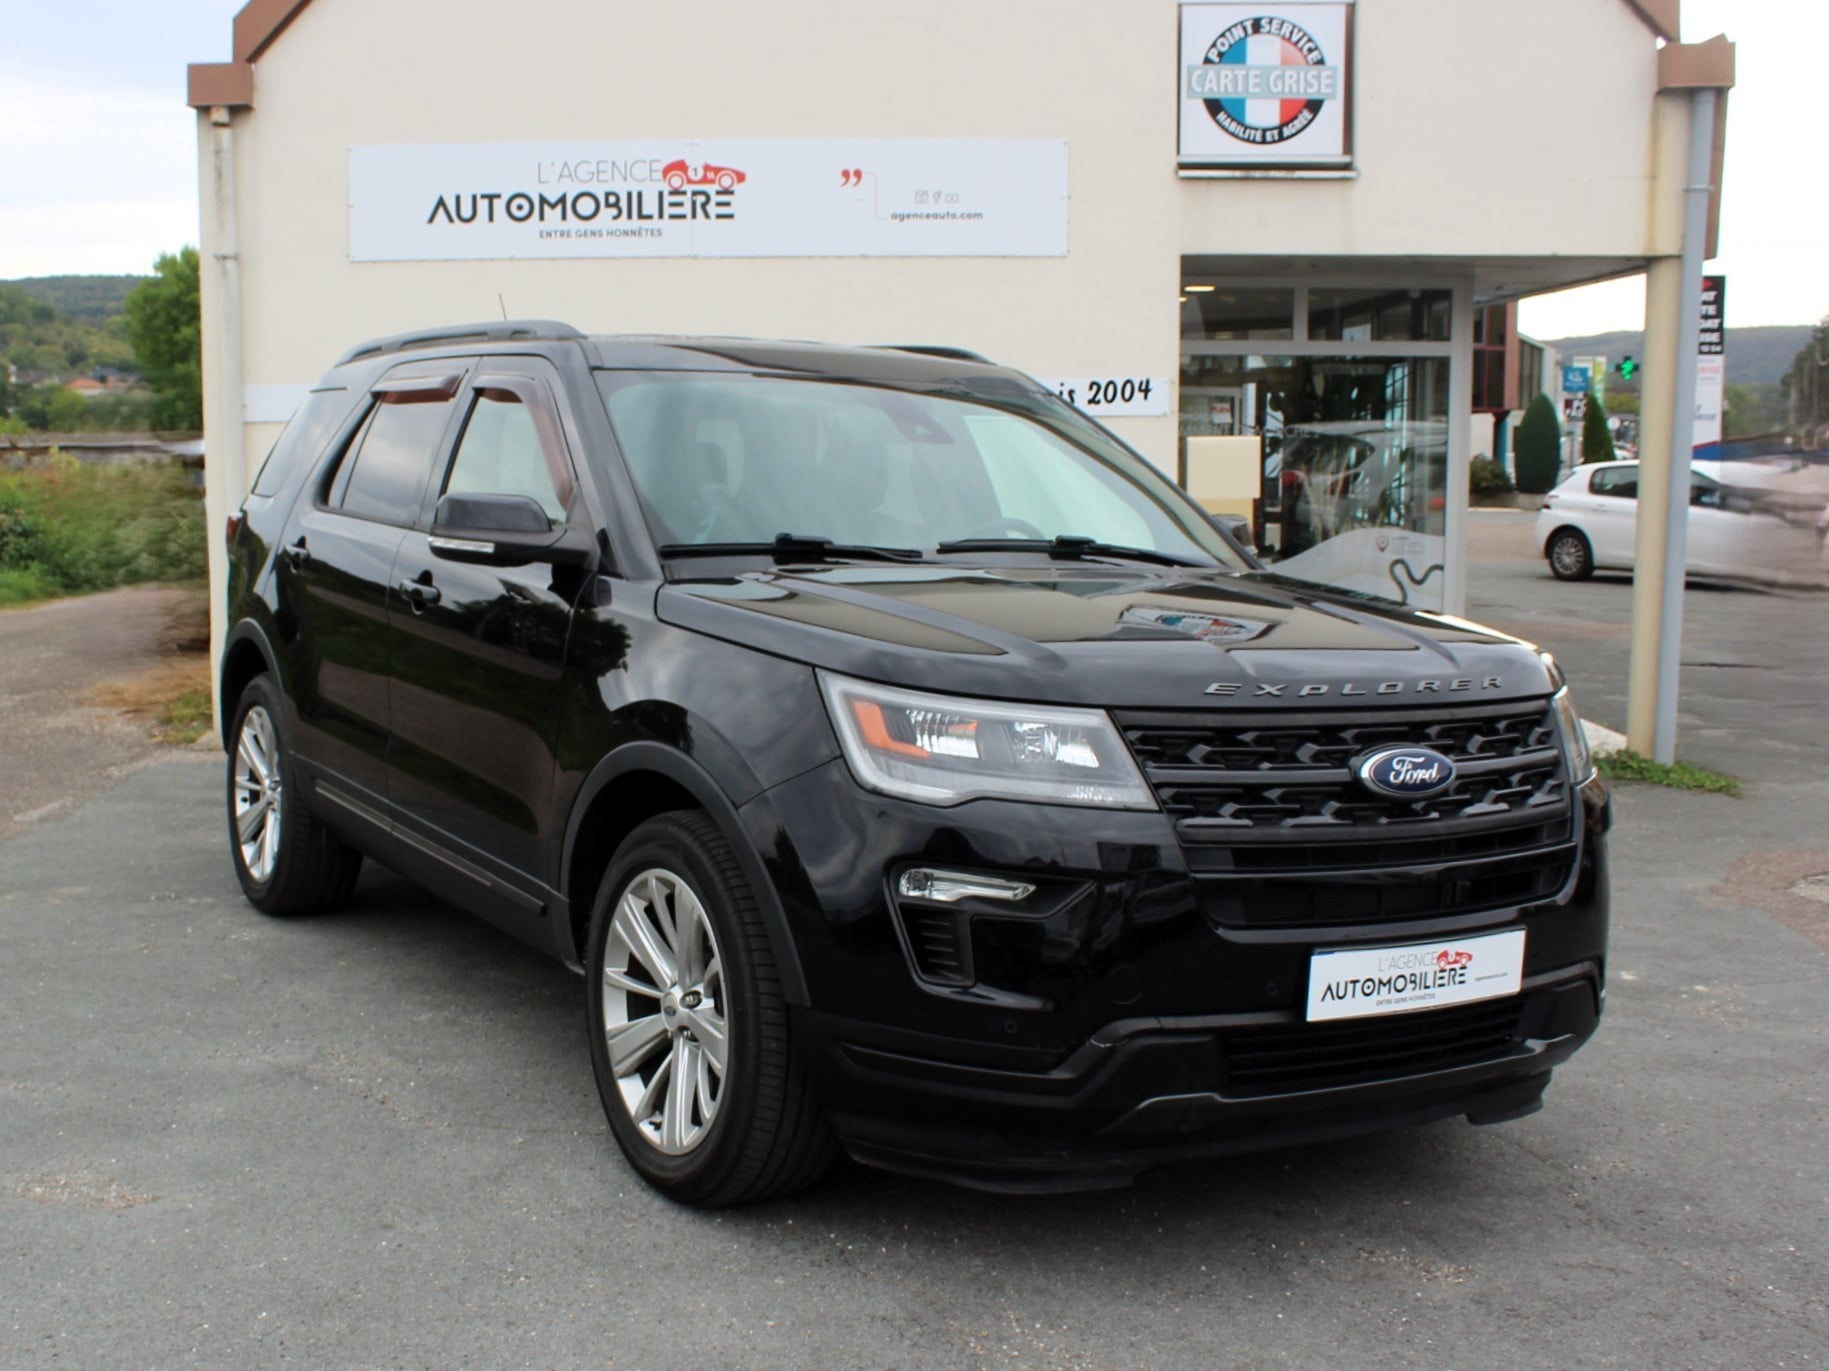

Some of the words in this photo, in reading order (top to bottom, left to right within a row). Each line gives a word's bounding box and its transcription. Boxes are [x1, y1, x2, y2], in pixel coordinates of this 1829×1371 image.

[1208, 19, 1255, 63] POINT
[1260, 17, 1322, 64] SERVICE
[1191, 70, 1261, 92] CARTE
[1269, 70, 1333, 93] GRISE
[1265, 129, 1280, 142] ET
[537, 159, 662, 184] L'AGENCE
[891, 211, 983, 222] agenceauto.com
[539, 230, 572, 239] ENTRE
[575, 229, 603, 238] GENS
[606, 226, 663, 238] HONNÊTES
[1087, 378, 1152, 405] 2004
[1203, 676, 1502, 697] EXPLORER
[1389, 756, 1438, 783] Ford
[1377, 951, 1437, 972] L'AGENCE
